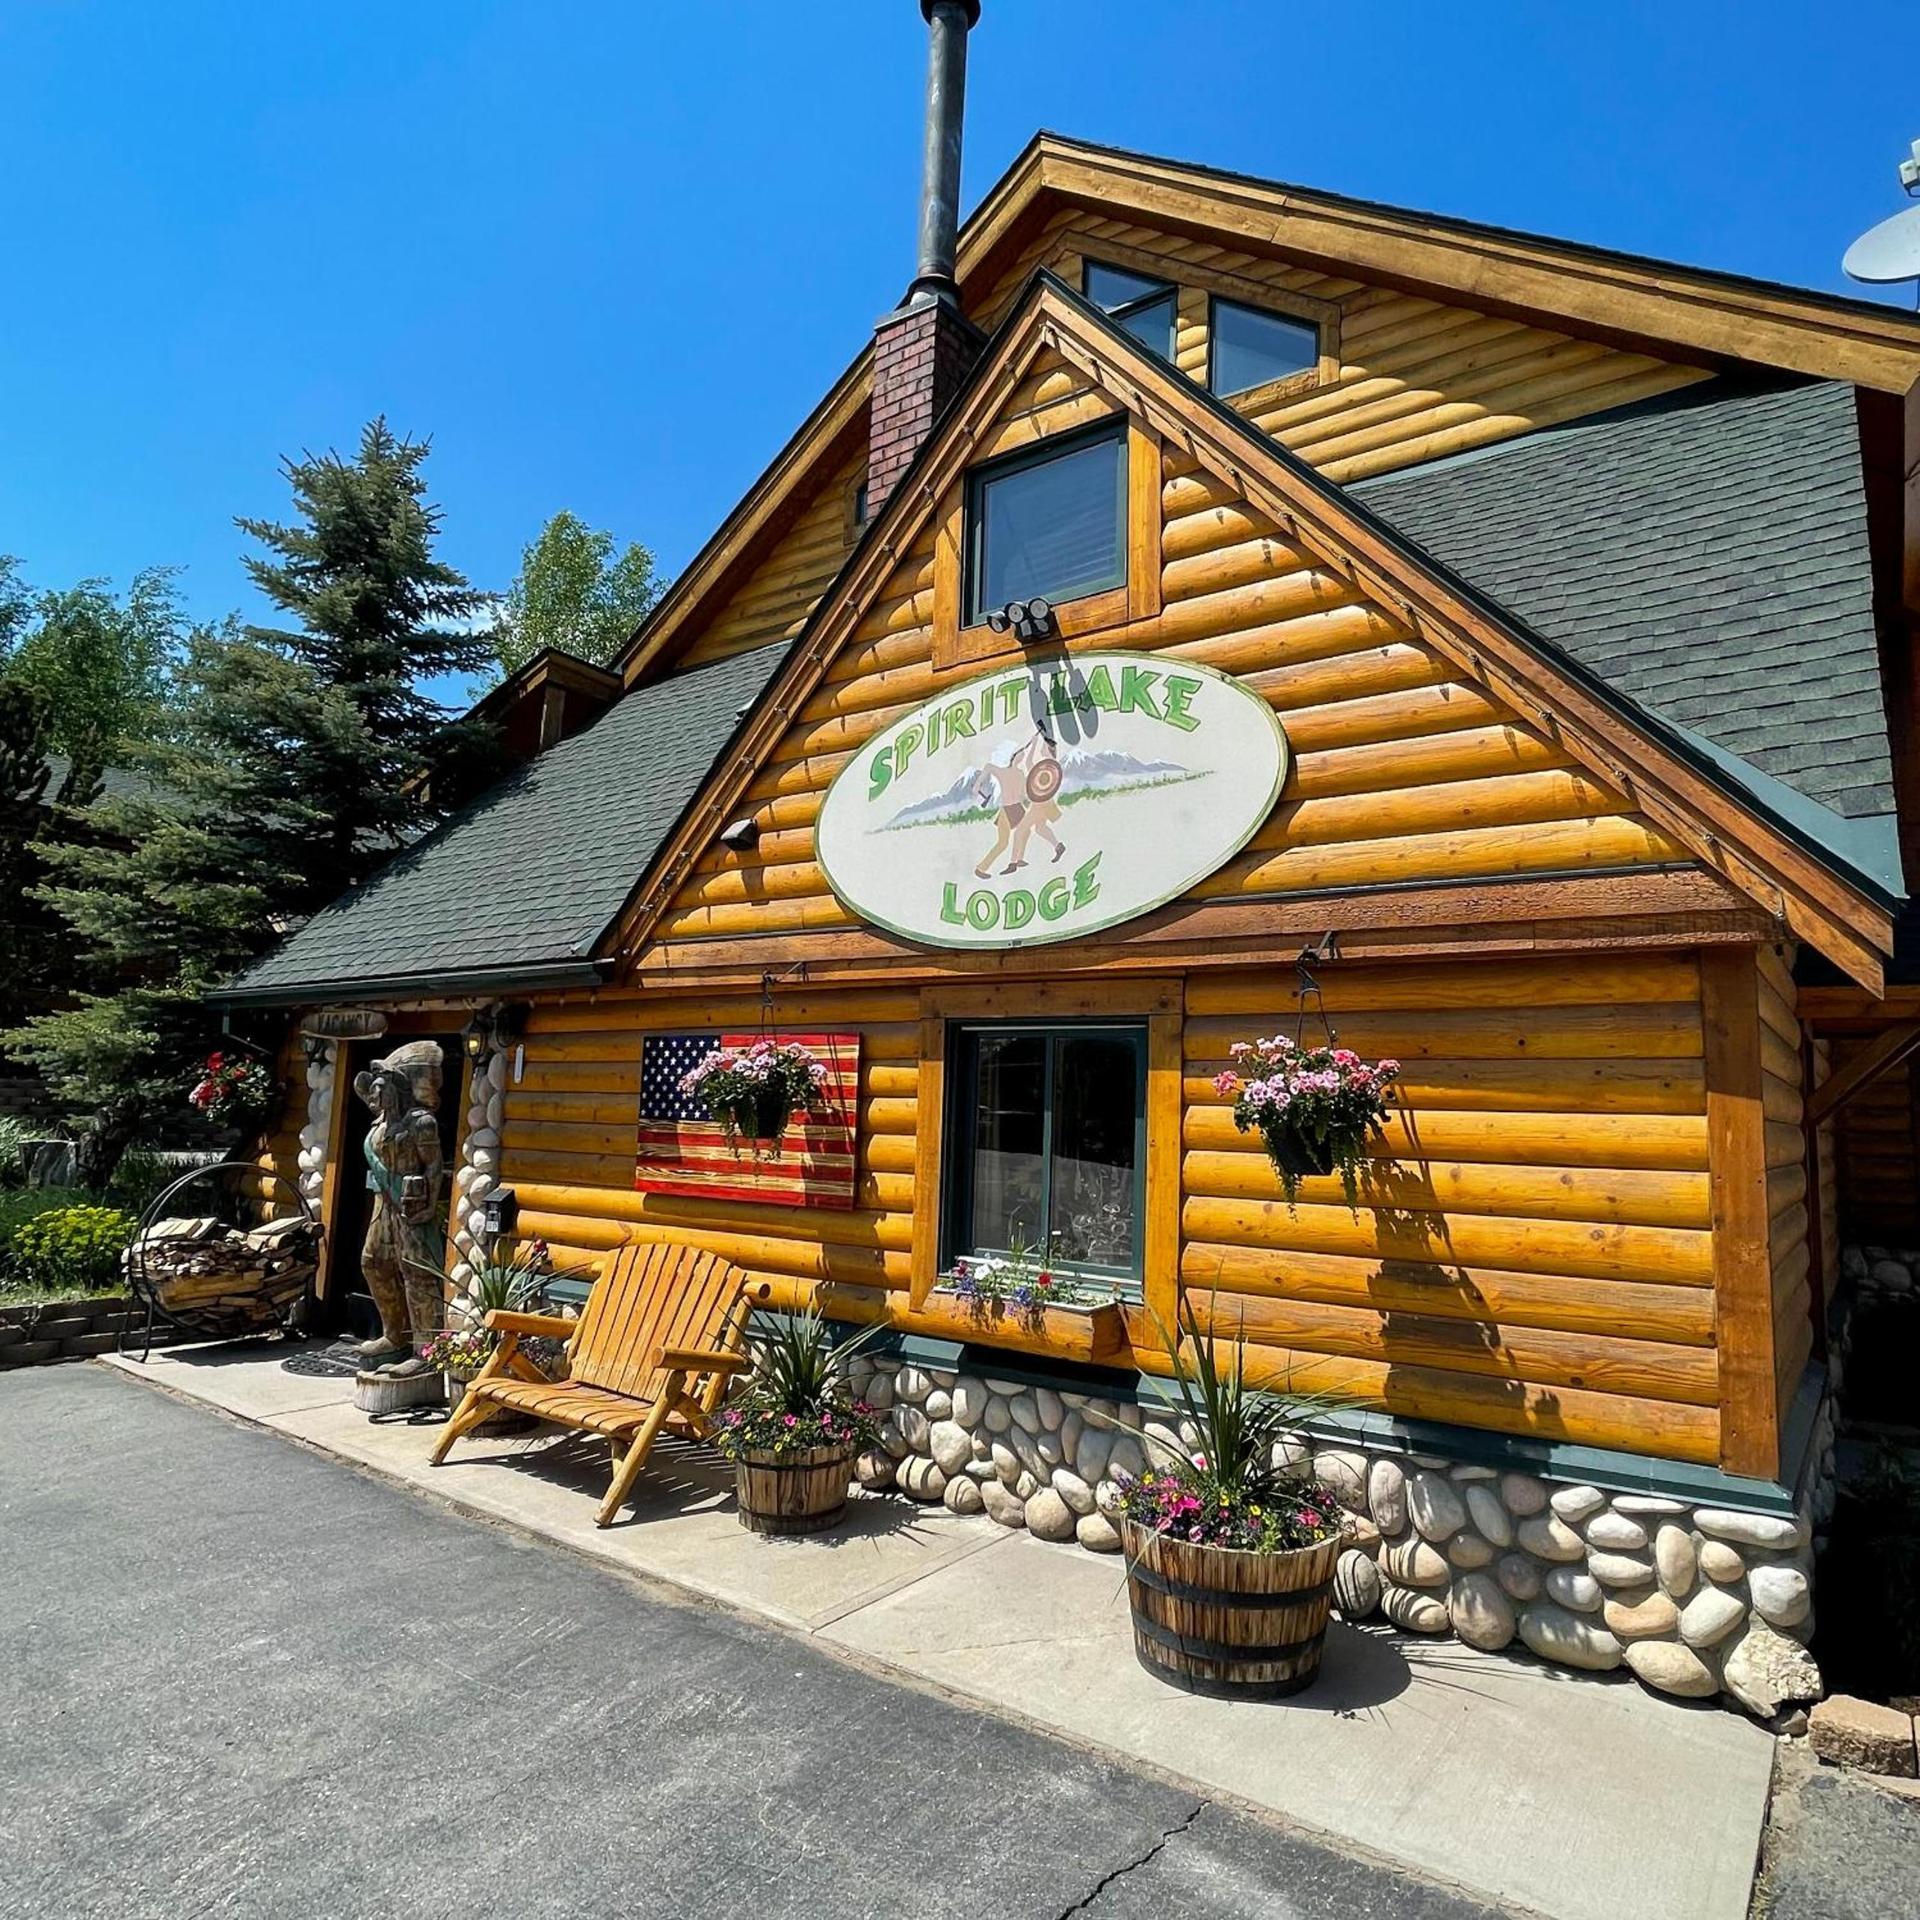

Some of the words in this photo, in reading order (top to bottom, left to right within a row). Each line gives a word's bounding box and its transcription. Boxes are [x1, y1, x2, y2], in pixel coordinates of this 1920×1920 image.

[869, 676, 1029, 802] SPIRIT
[1047, 665, 1202, 732] LAKE
[941, 851, 1103, 931] LODGE
